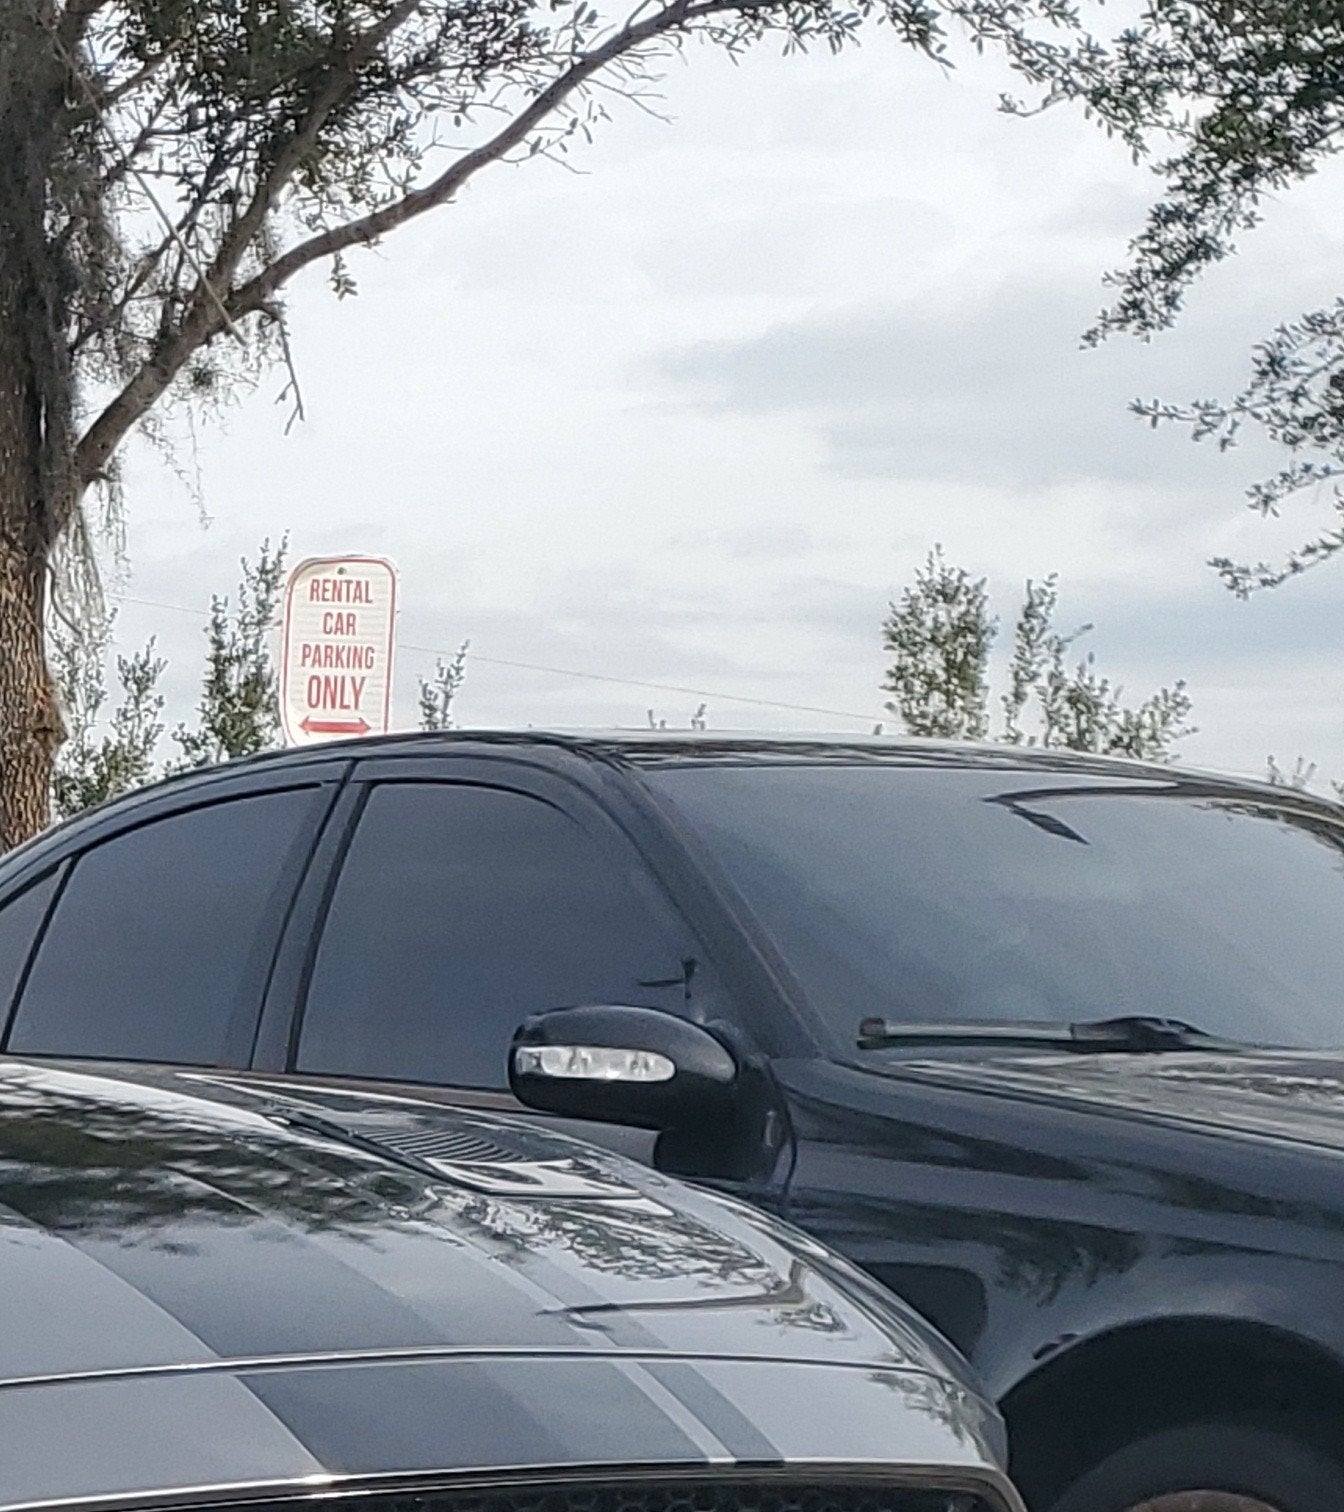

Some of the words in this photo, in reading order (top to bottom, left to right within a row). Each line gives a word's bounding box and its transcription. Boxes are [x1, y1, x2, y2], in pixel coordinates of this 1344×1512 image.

[309, 579, 373, 603] RENTAL
[322, 613, 357, 635] CAR
[301, 644, 375, 669] PARKING
[307, 675, 365, 710] ONLY
